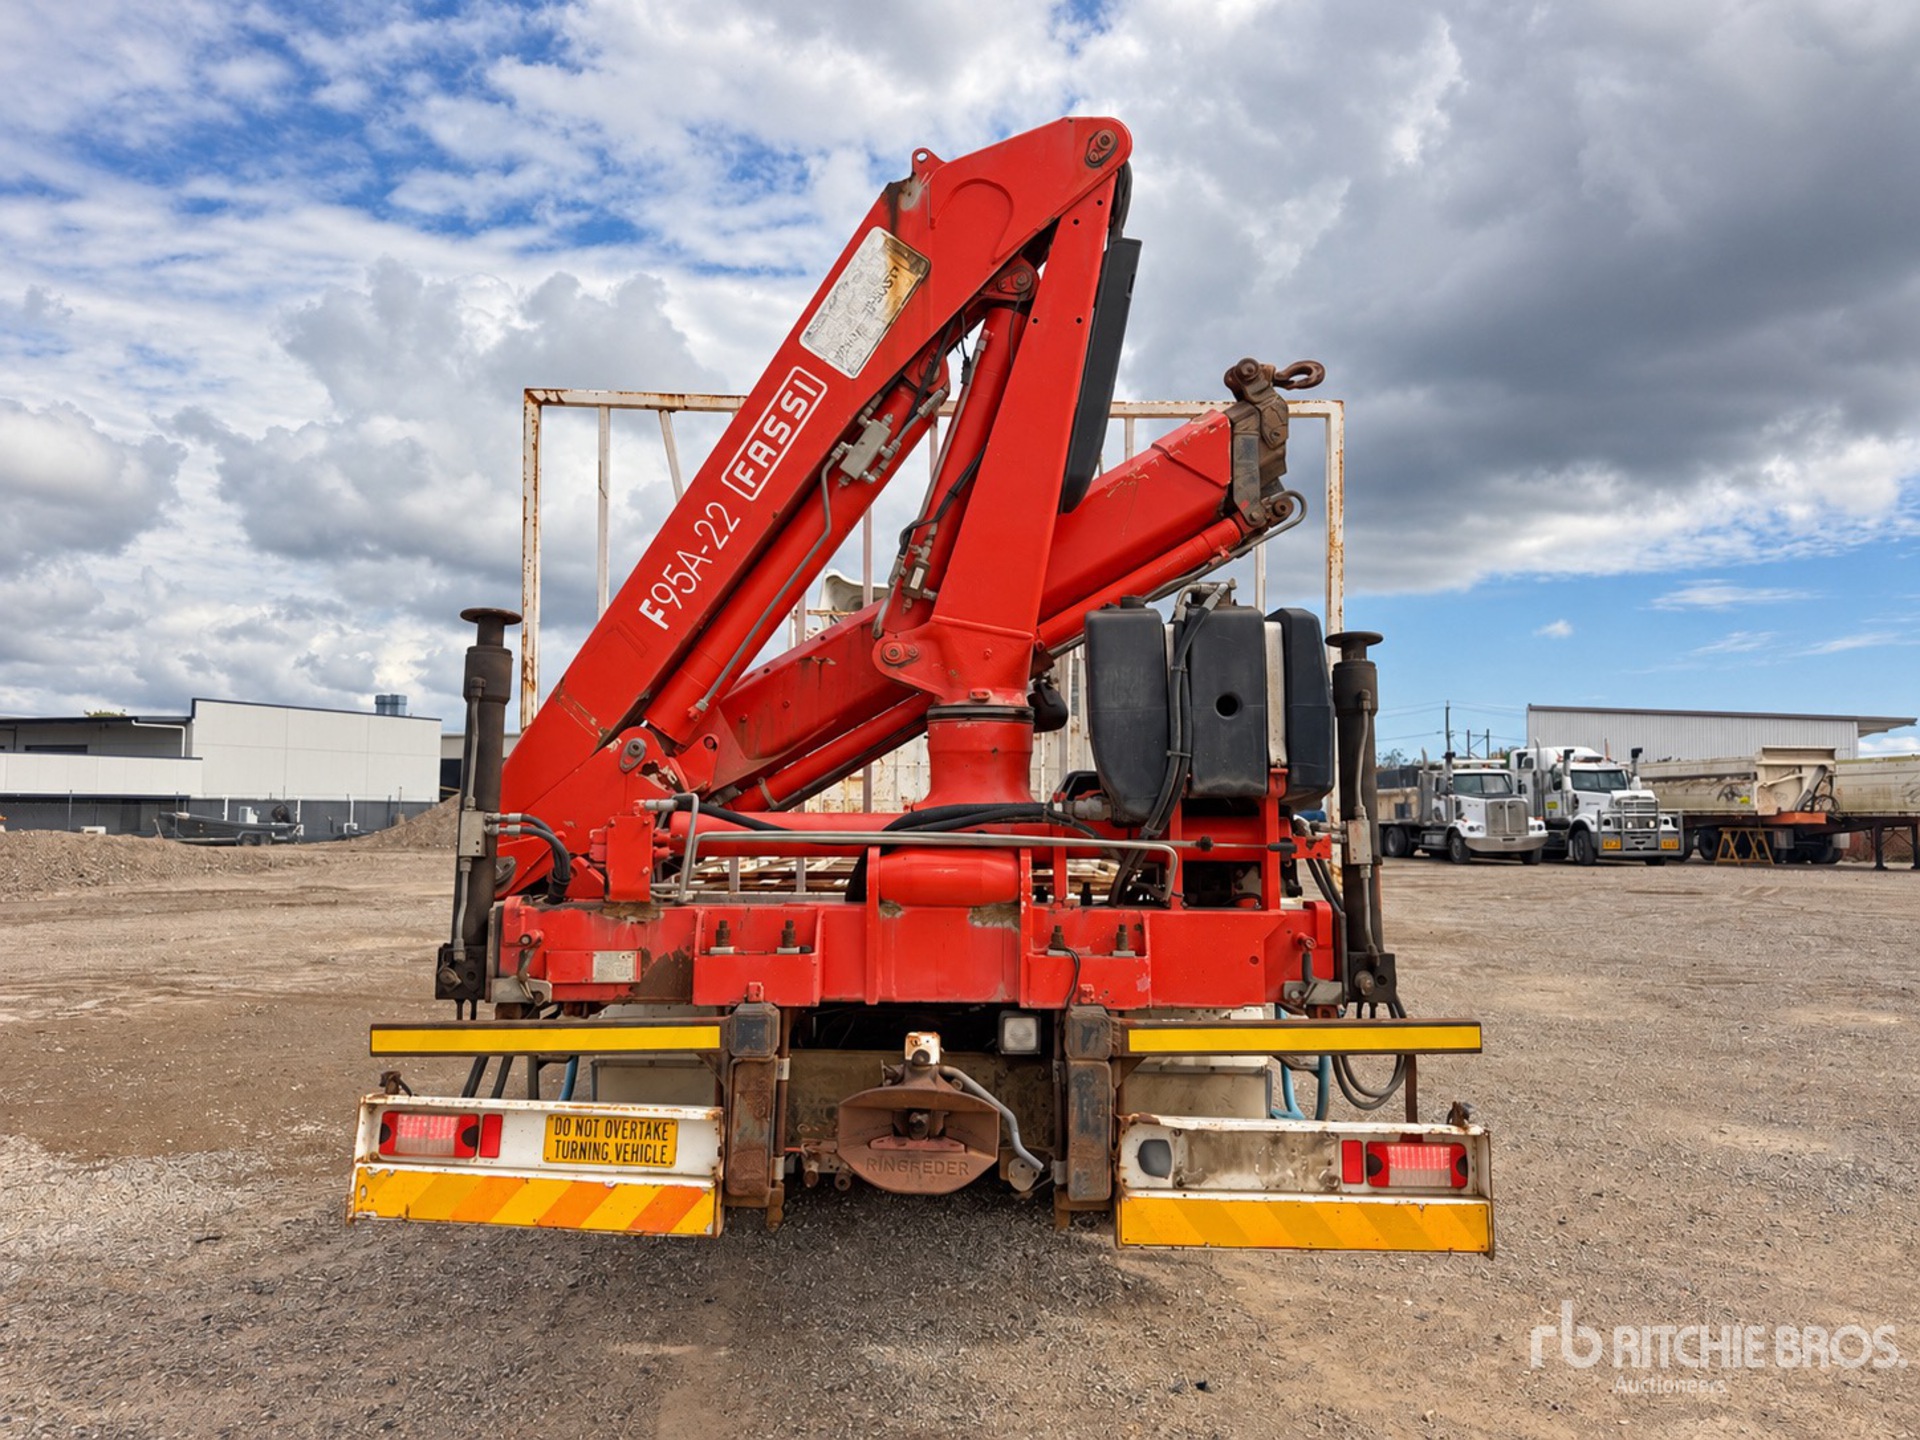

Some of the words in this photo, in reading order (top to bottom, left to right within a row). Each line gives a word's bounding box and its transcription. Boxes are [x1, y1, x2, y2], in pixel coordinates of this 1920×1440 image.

[734, 379, 818, 489] FASSI
[638, 501, 741, 630] F95A-22
[554, 1117, 571, 1137] DO
[575, 1118, 600, 1139] NOT
[605, 1119, 669, 1141] OVERTAKE
[555, 1140, 609, 1161] TURNING
[614, 1143, 668, 1164] VEHICLE
